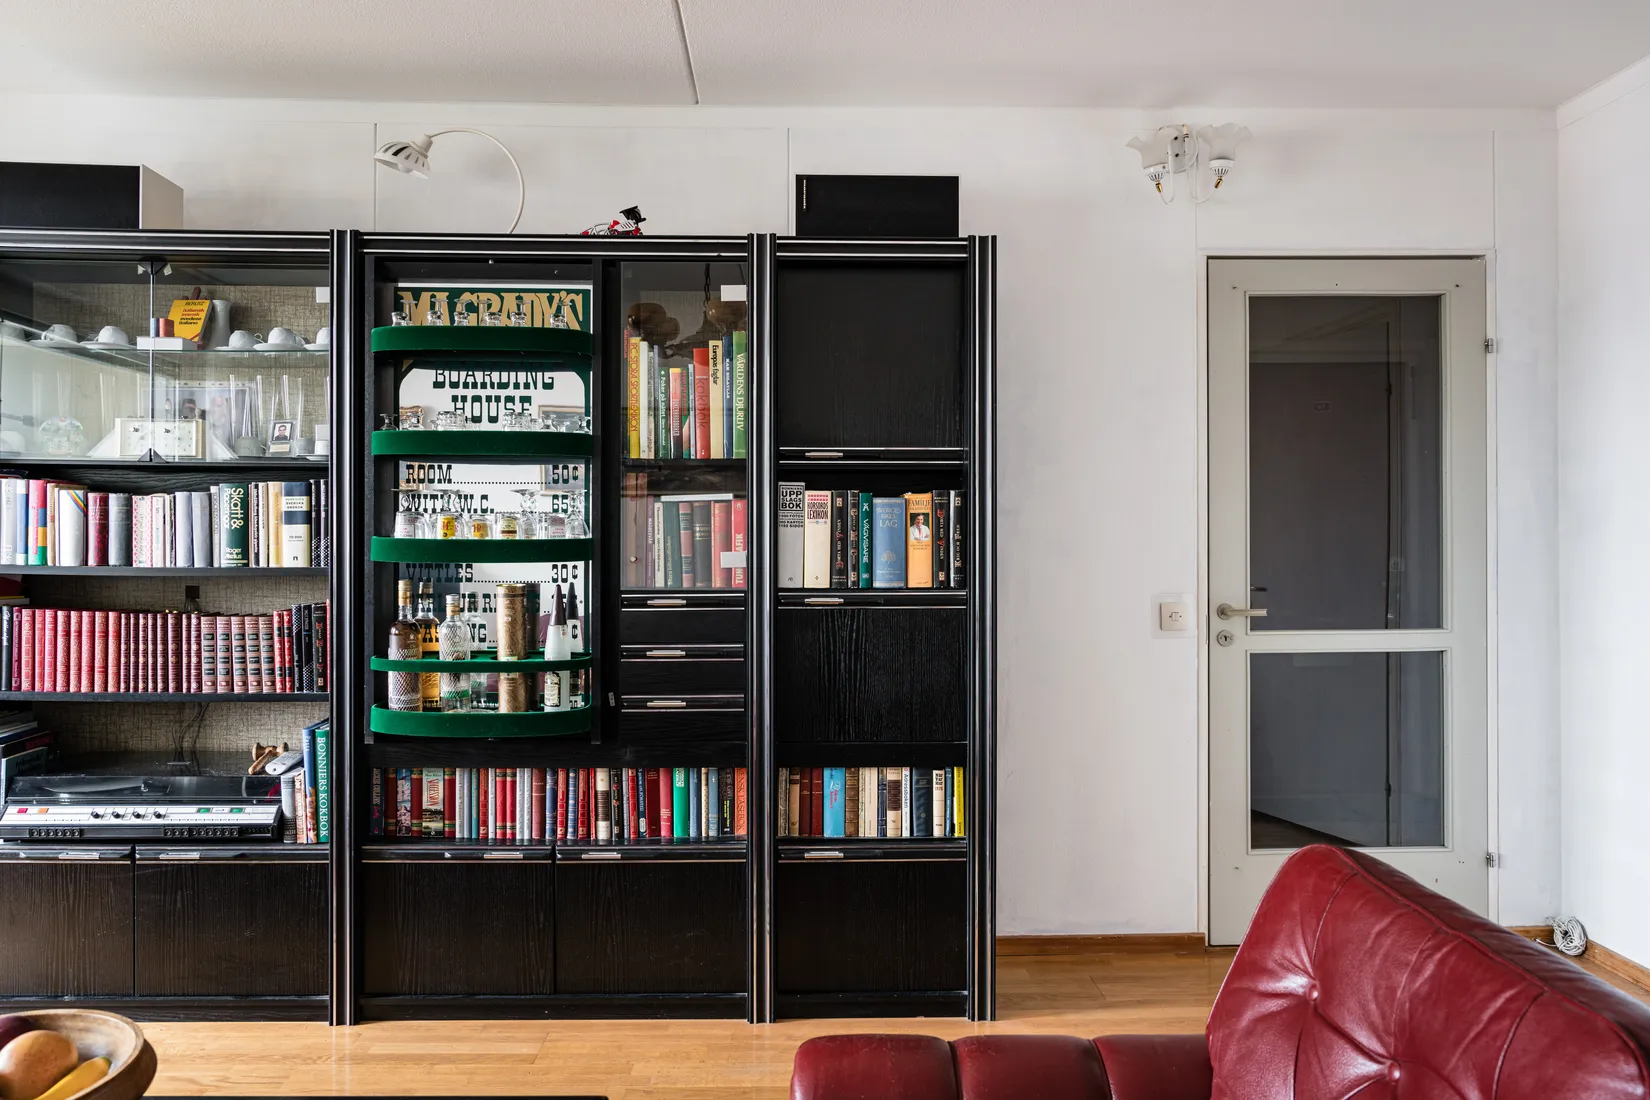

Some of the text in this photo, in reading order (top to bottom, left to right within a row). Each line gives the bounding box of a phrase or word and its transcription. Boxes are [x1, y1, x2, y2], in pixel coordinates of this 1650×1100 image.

[711, 345, 720, 368] Europas
[432, 370, 554, 390] BOARDING
[735, 353, 745, 431] VÄRLDENS DJURLIV
[451, 395, 532, 425] HOUSE
[696, 379, 708, 429] kokbok
[406, 464, 453, 485] ROOM
[781, 490, 802, 498] UPP
[231, 488, 244, 530] Skatt &
[879, 519, 898, 528] LAG
[405, 563, 474, 584] VITTLES
[317, 737, 328, 838] BONNIERS KOKBOK
